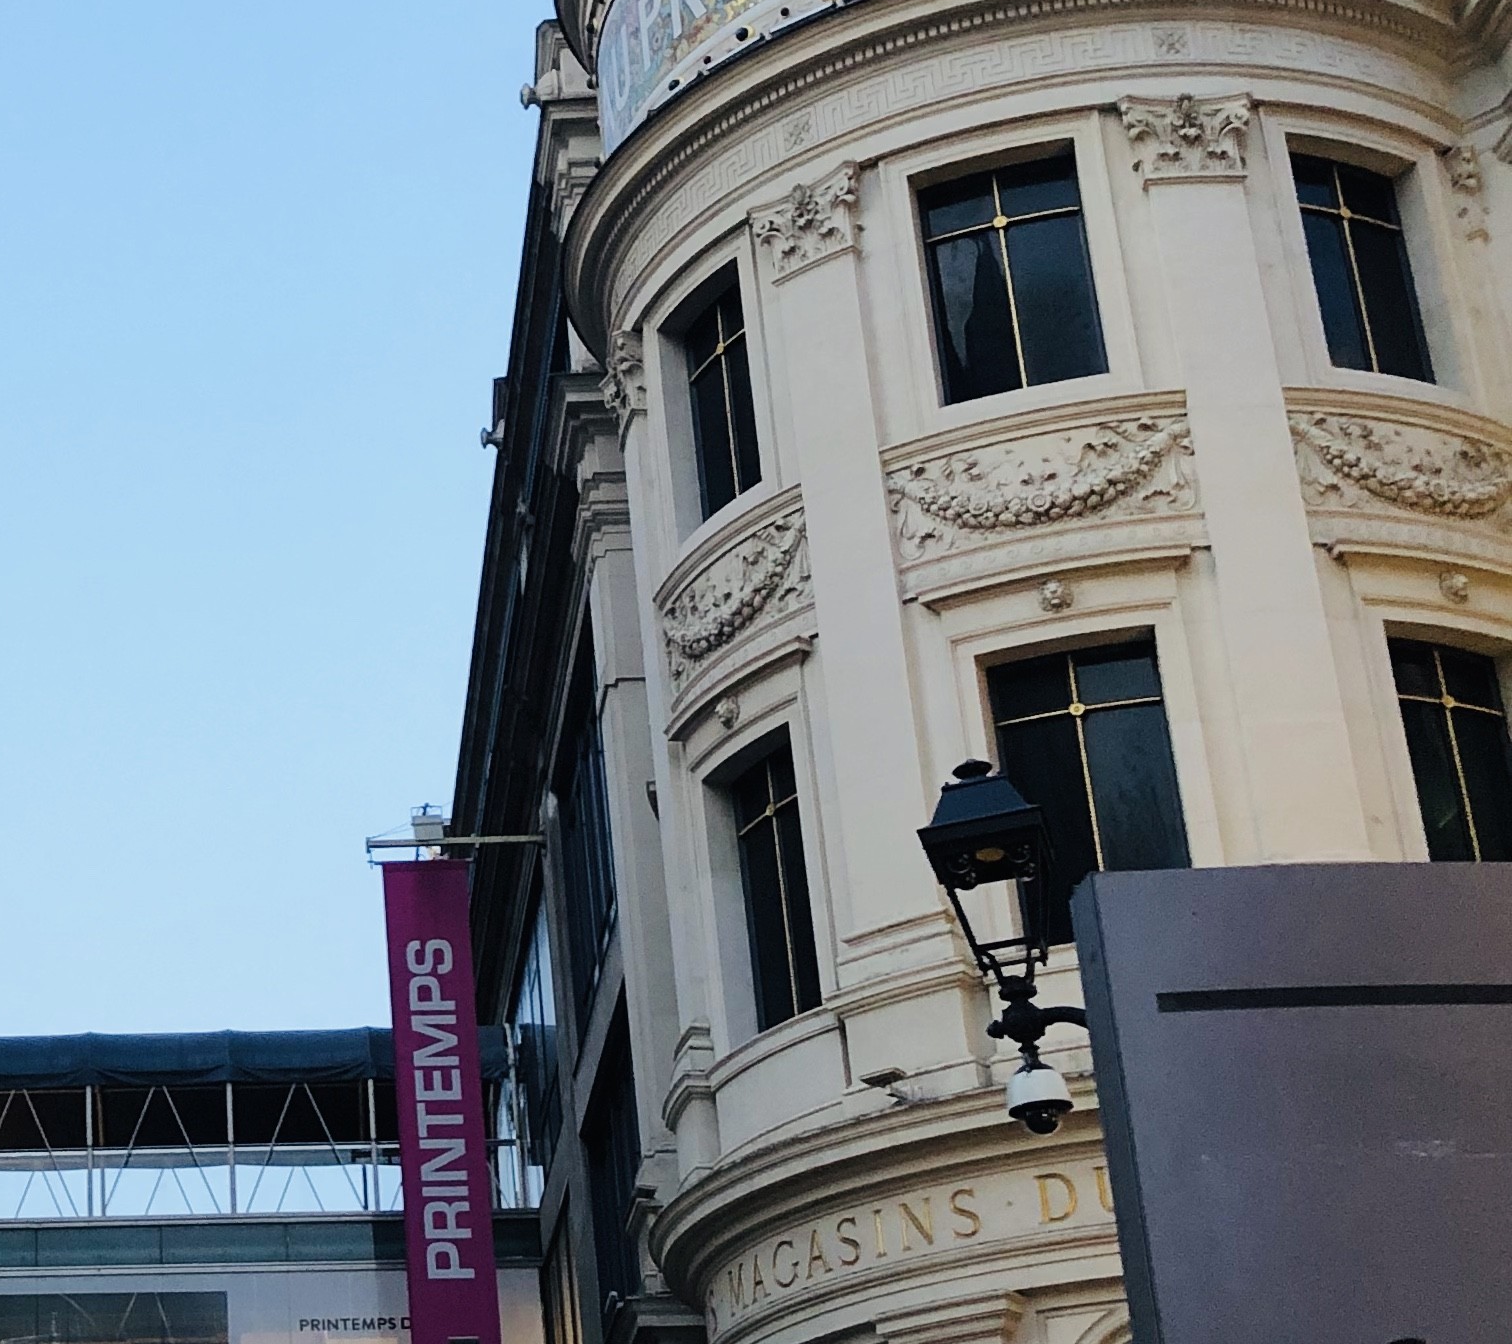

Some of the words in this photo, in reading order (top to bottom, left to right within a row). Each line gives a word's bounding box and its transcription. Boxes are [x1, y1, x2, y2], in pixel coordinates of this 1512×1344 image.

[405, 938, 476, 1281] PRINTEMPS
[727, 1188, 983, 1318] MAGASINS
[299, 1318, 397, 1332] PRINTEMPS
